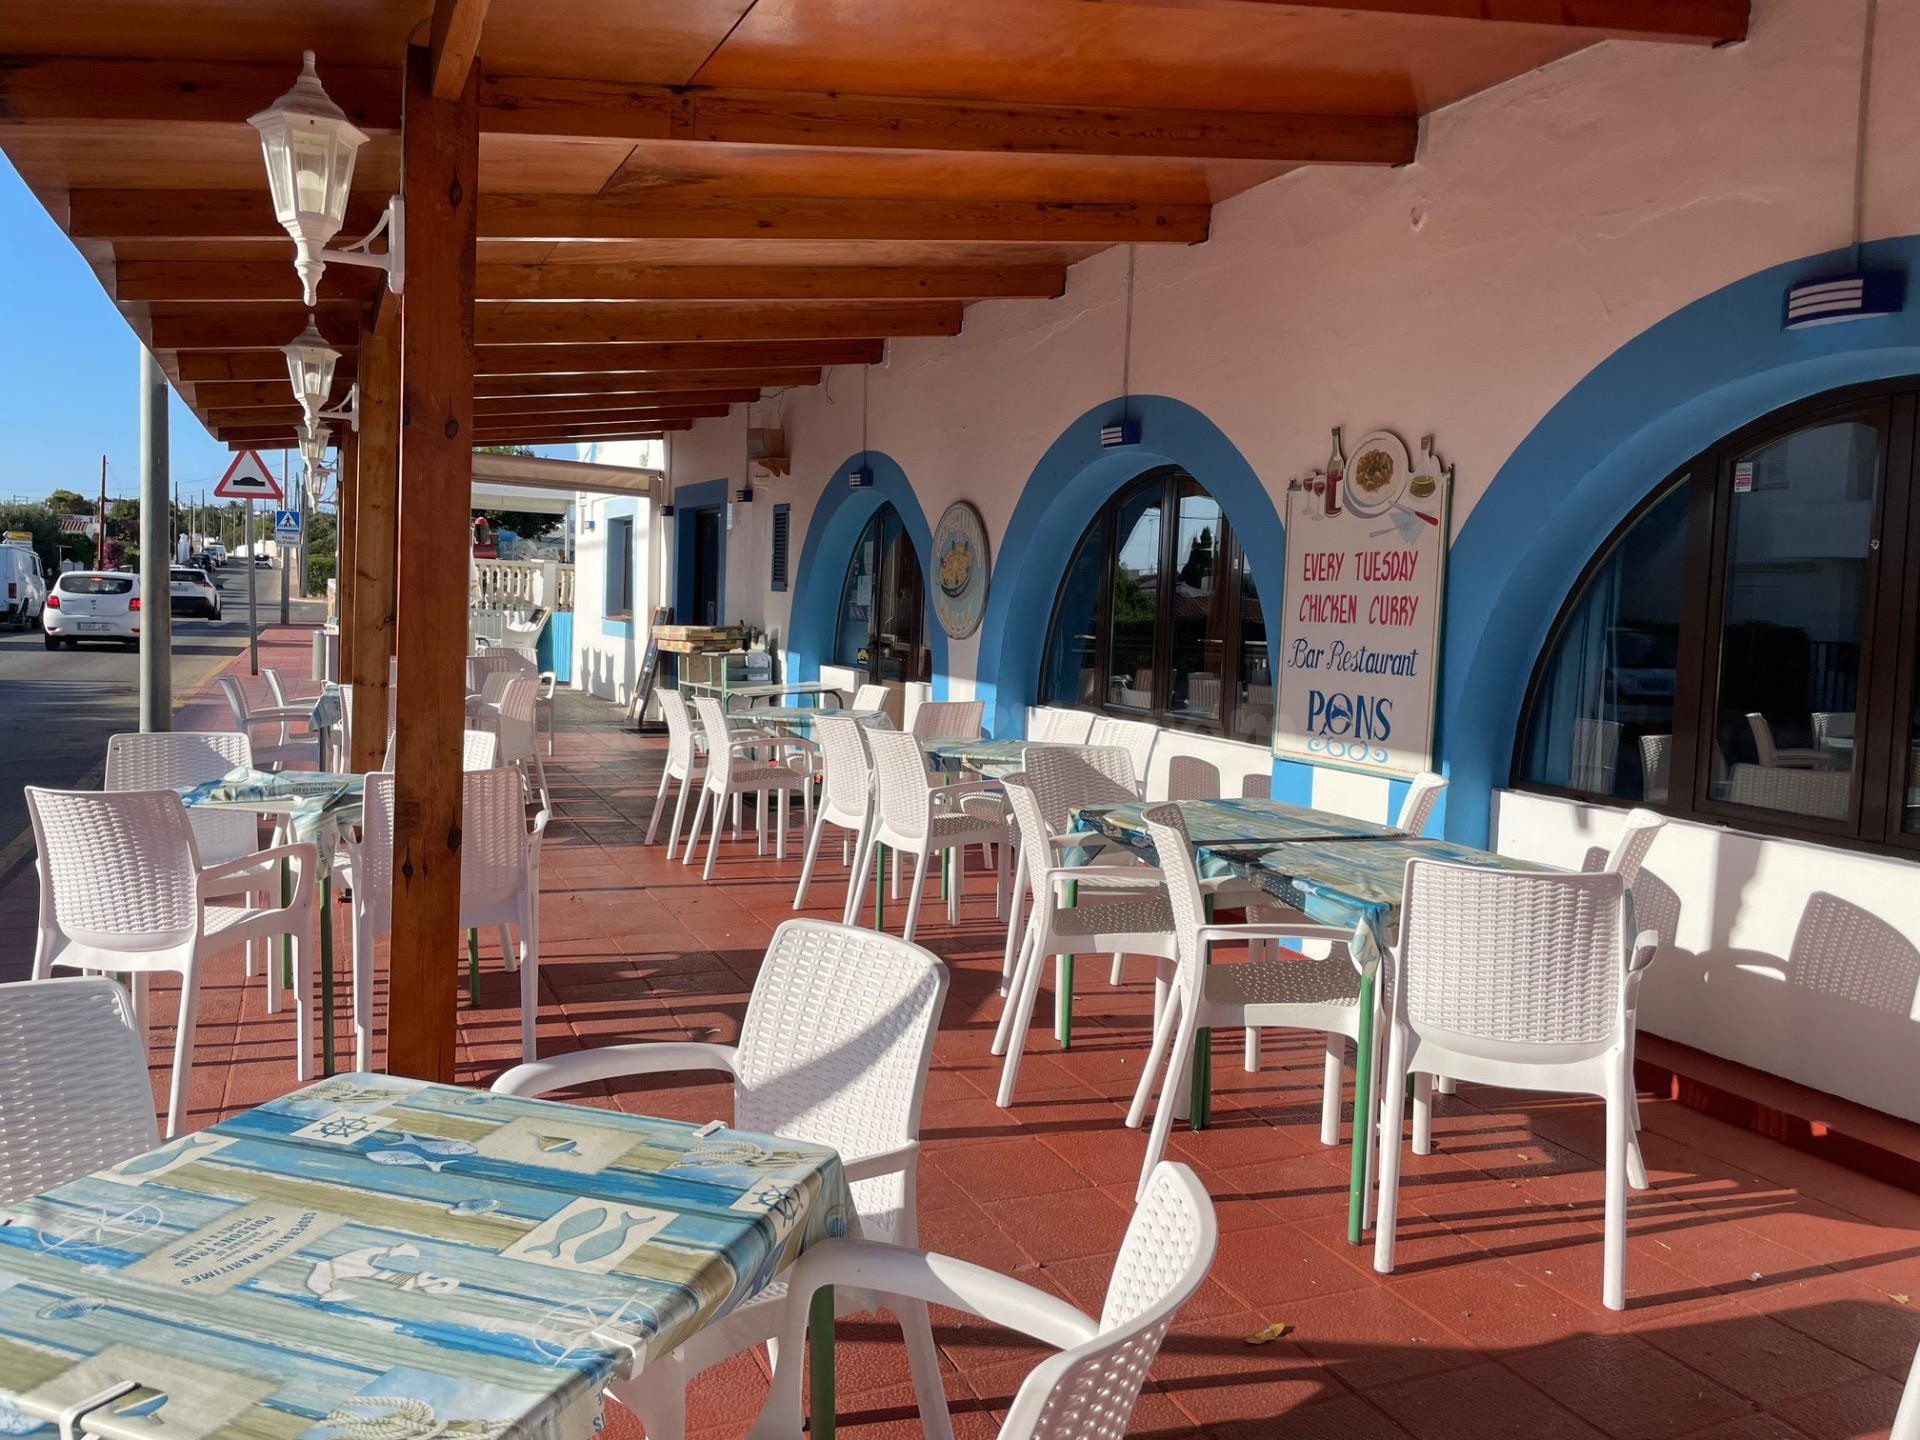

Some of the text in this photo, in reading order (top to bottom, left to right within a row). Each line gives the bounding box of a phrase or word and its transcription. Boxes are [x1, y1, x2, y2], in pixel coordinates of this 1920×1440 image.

[1303, 551, 1419, 582] EVERY TUESDAY
[1299, 594, 1419, 626] CHICKEN CURRY
[1287, 637, 1420, 677] Bar Restaurant
[1306, 689, 1393, 741] PONS
[212, 1215, 277, 1248] POISSONS
[174, 1246, 216, 1269] FRAIS
[180, 1252, 264, 1286] MARITIMES
